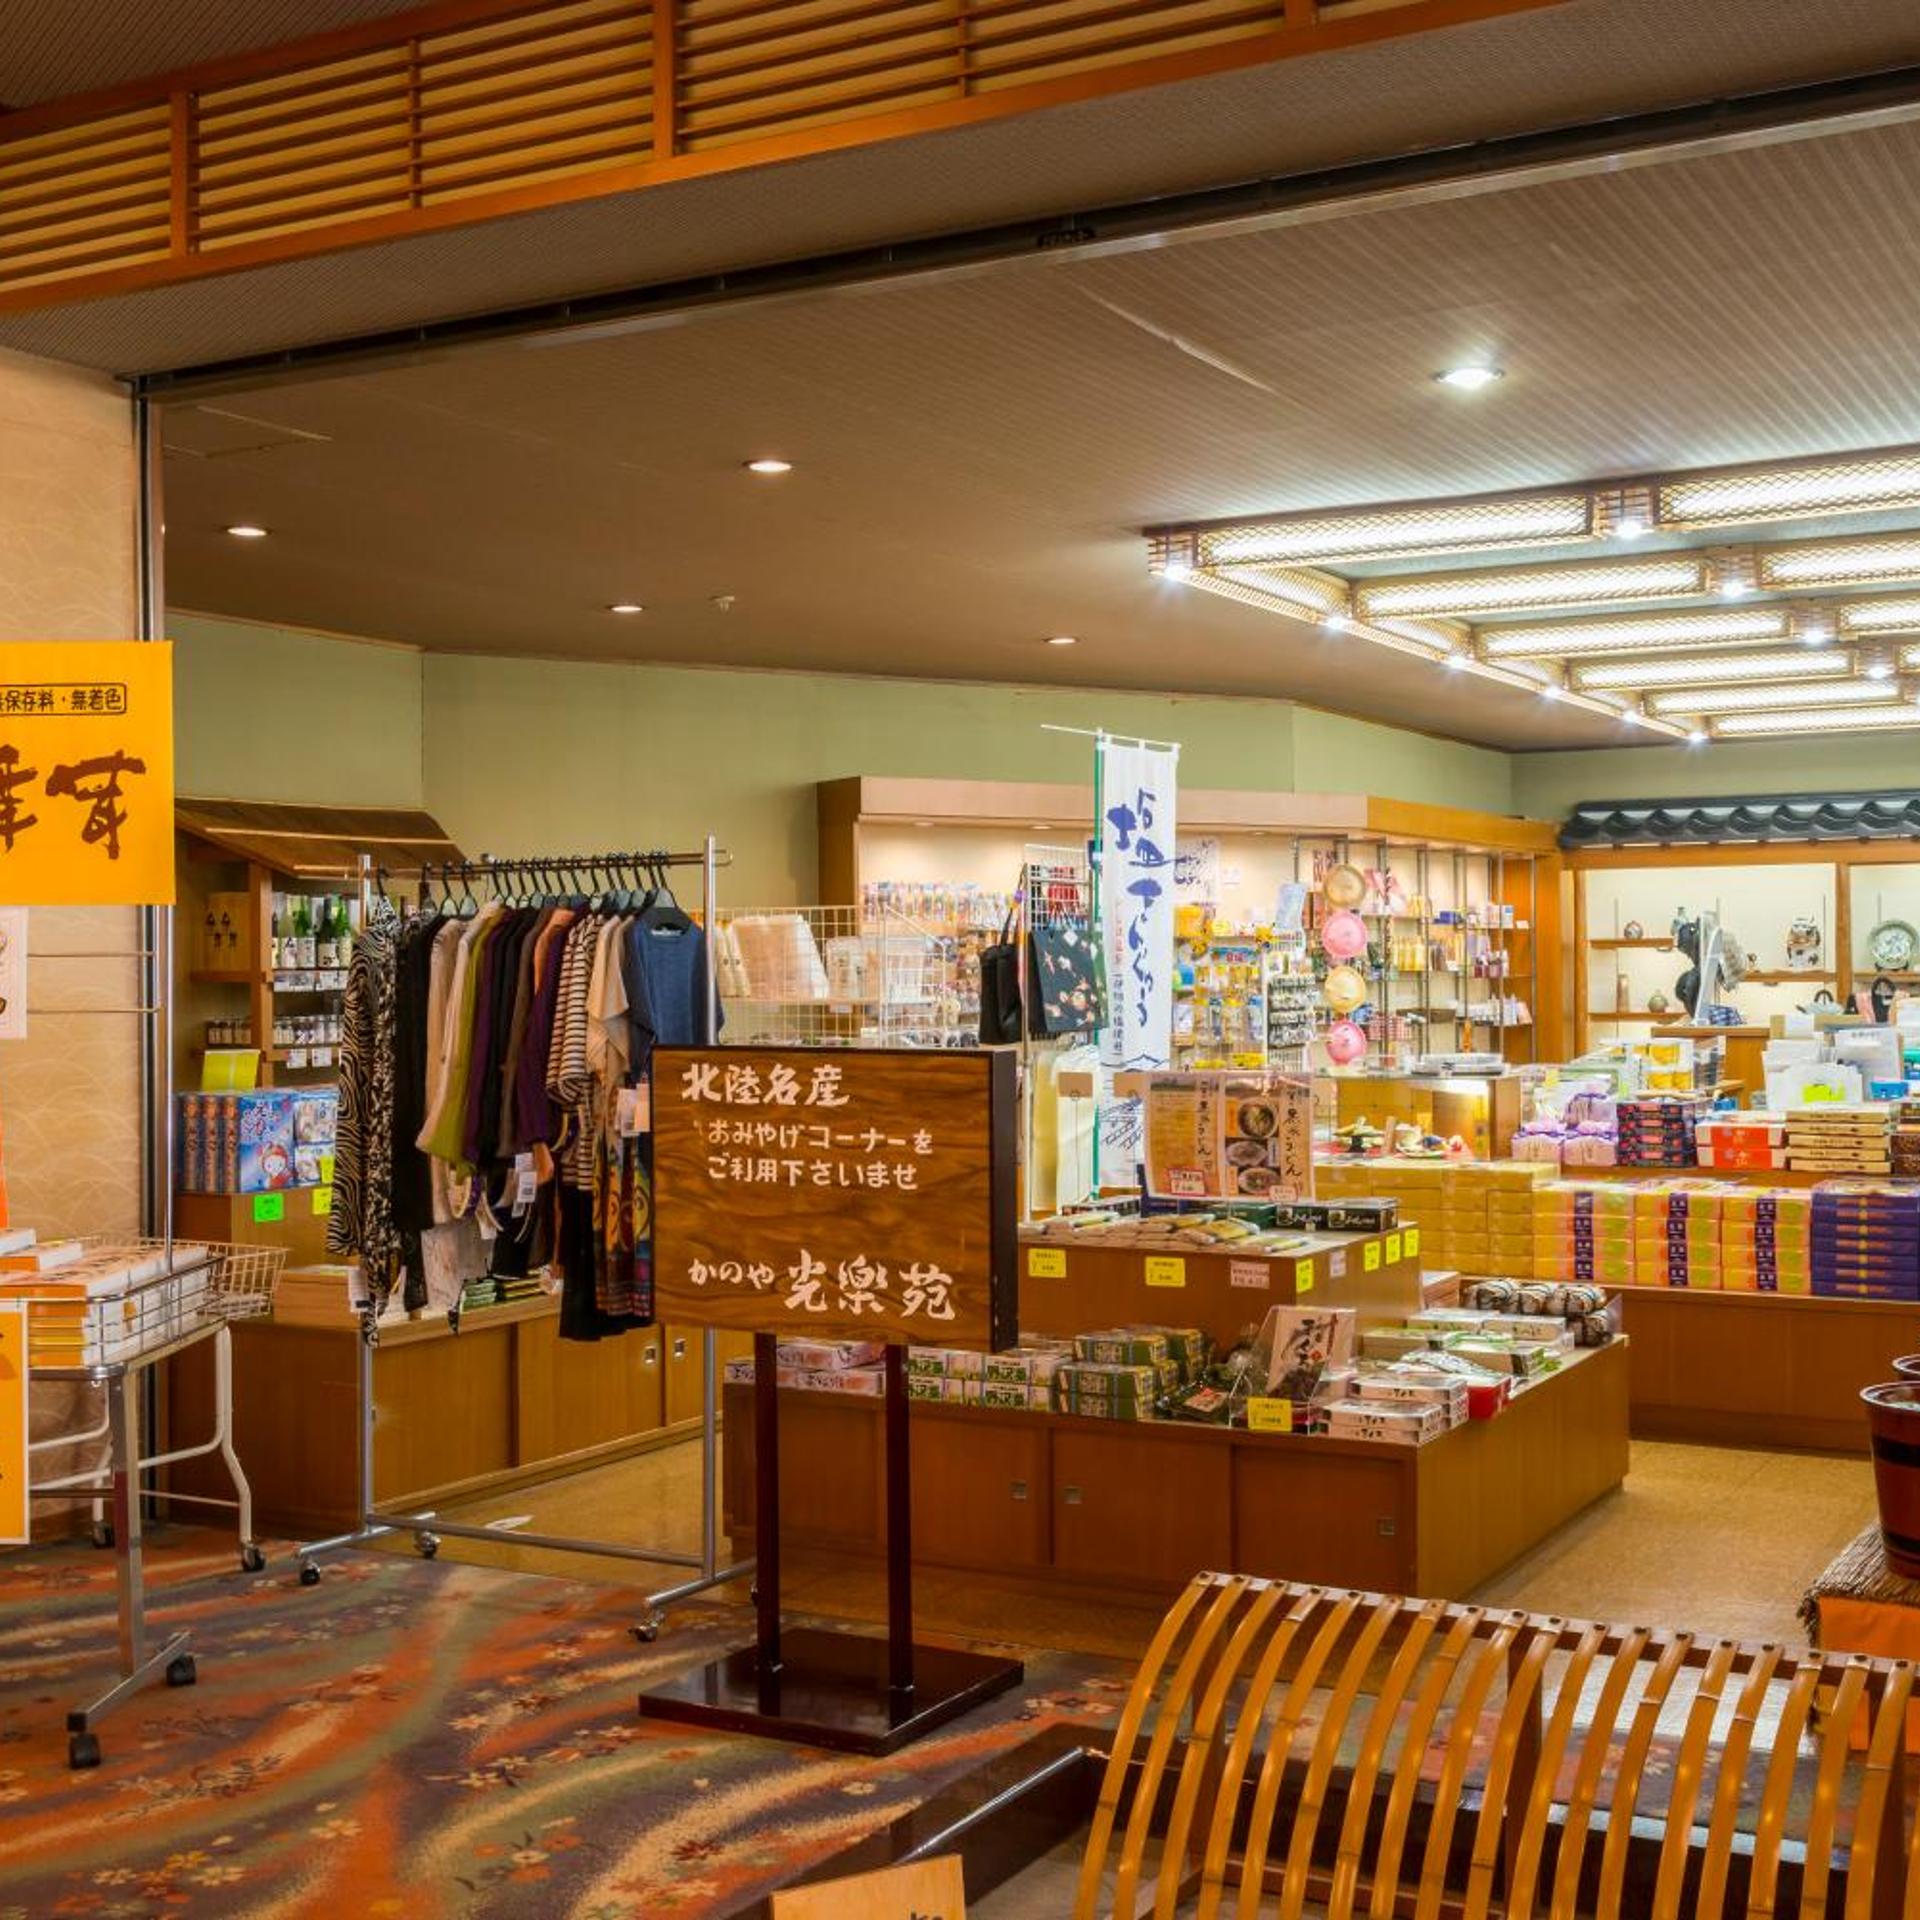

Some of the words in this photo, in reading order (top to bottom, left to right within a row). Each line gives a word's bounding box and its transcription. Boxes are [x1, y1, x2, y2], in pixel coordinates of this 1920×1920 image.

[0, 688, 122, 712] 保存料・無着色
[681, 1062, 850, 1107] 北陸名産
[707, 1119, 933, 1155] おみやげコーナーを
[707, 1152, 918, 1191] ご利用下さいませ
